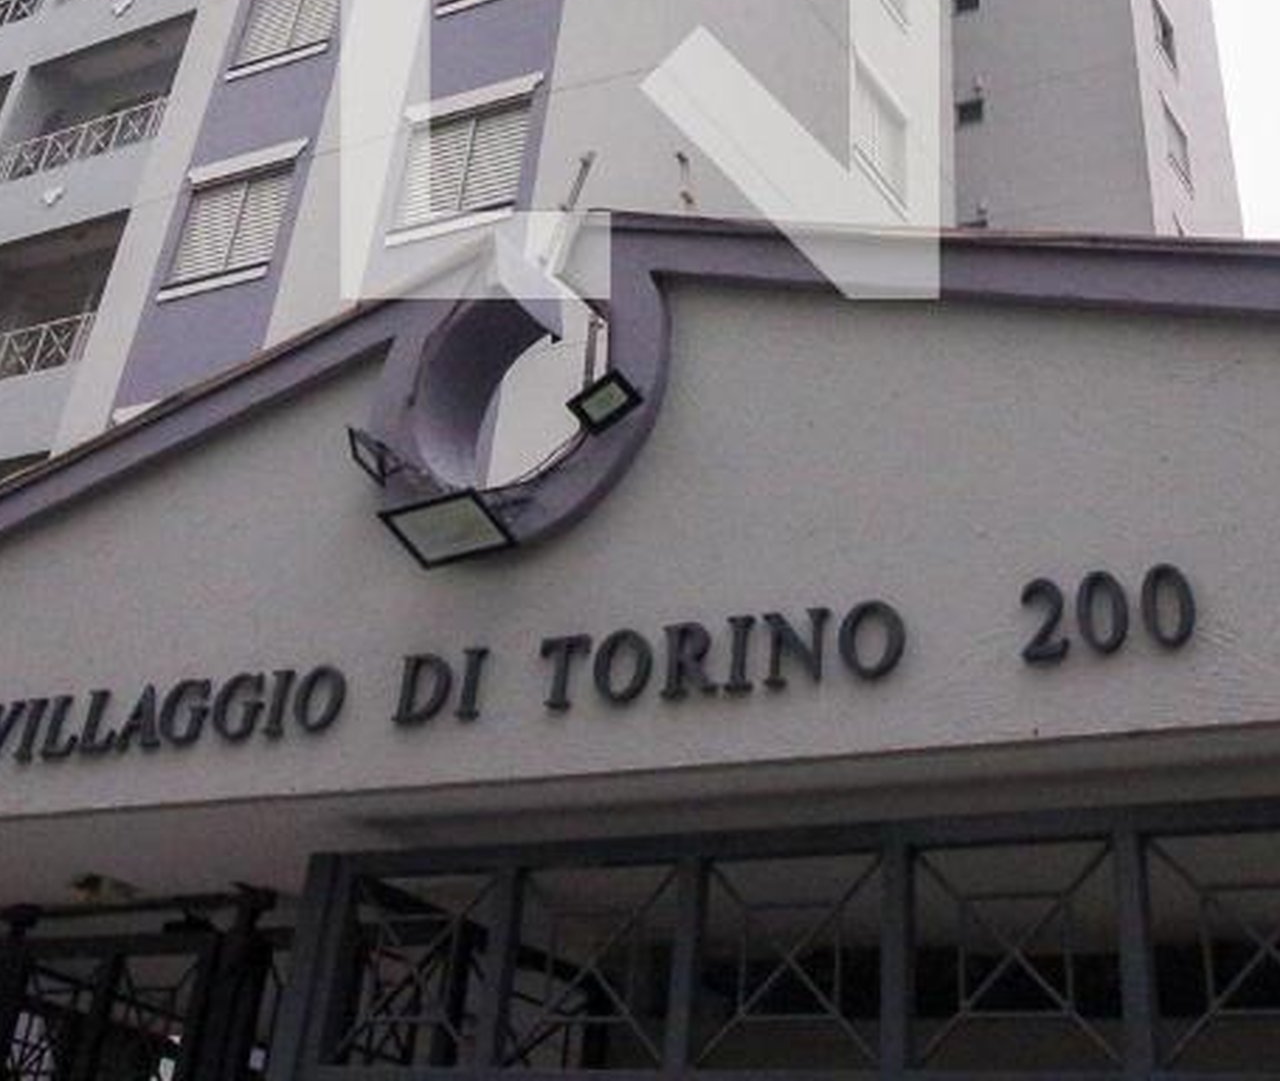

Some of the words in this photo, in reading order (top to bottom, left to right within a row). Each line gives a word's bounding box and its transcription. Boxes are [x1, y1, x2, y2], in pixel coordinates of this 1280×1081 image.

[390, 646, 491, 723] DI
[540, 600, 907, 712] TORINO
[1020, 563, 1197, 664] 200
